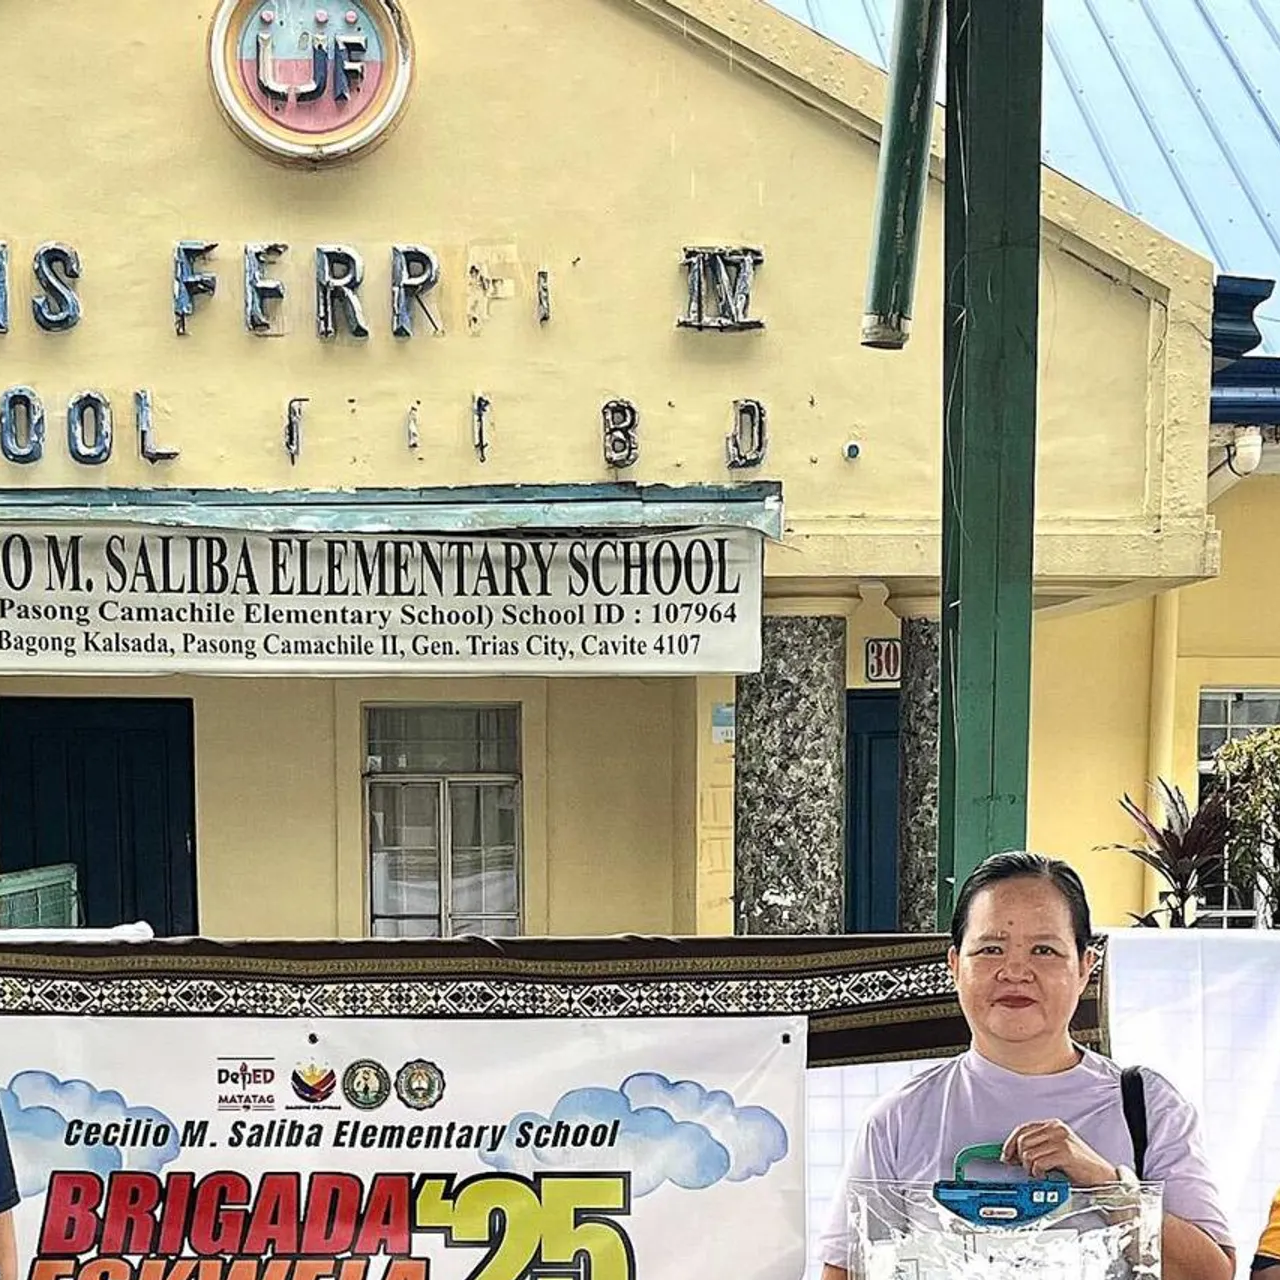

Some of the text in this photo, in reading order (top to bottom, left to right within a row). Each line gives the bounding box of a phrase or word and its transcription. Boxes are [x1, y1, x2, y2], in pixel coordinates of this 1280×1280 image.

[173, 242, 550, 339] FERR
[676, 245, 766, 331] IV
[45, 534, 94, 594] M.
[105, 534, 259, 597] SALIBA
[269, 537, 557, 597] ELEMENTARY
[568, 537, 741, 597] SCHOOL
[98, 599, 235, 625] Camachile
[244, 601, 393, 629] Elementary
[400, 603, 495, 629] School)
[502, 603, 584, 626] School
[595, 605, 625, 625] ID
[652, 602, 737, 625] 107964
[84, 631, 176, 657] Kalsada,
[183, 633, 257, 660] Pasong
[263, 633, 374, 656] Camachile
[381, 635, 406, 658] II,
[412, 635, 460, 656] Gen.
[466, 635, 519, 656] Trias
[526, 635, 575, 660] City,
[582, 635, 648, 656] Cavite
[653, 635, 701, 656] 4107
[871, 641, 899, 677] 30
[218, 1095, 275, 1104] MATATAG
[65, 1119, 622, 1151] Cecilio M. Saliba Elementary School
[37, 1171, 418, 1257] BRIGADA
